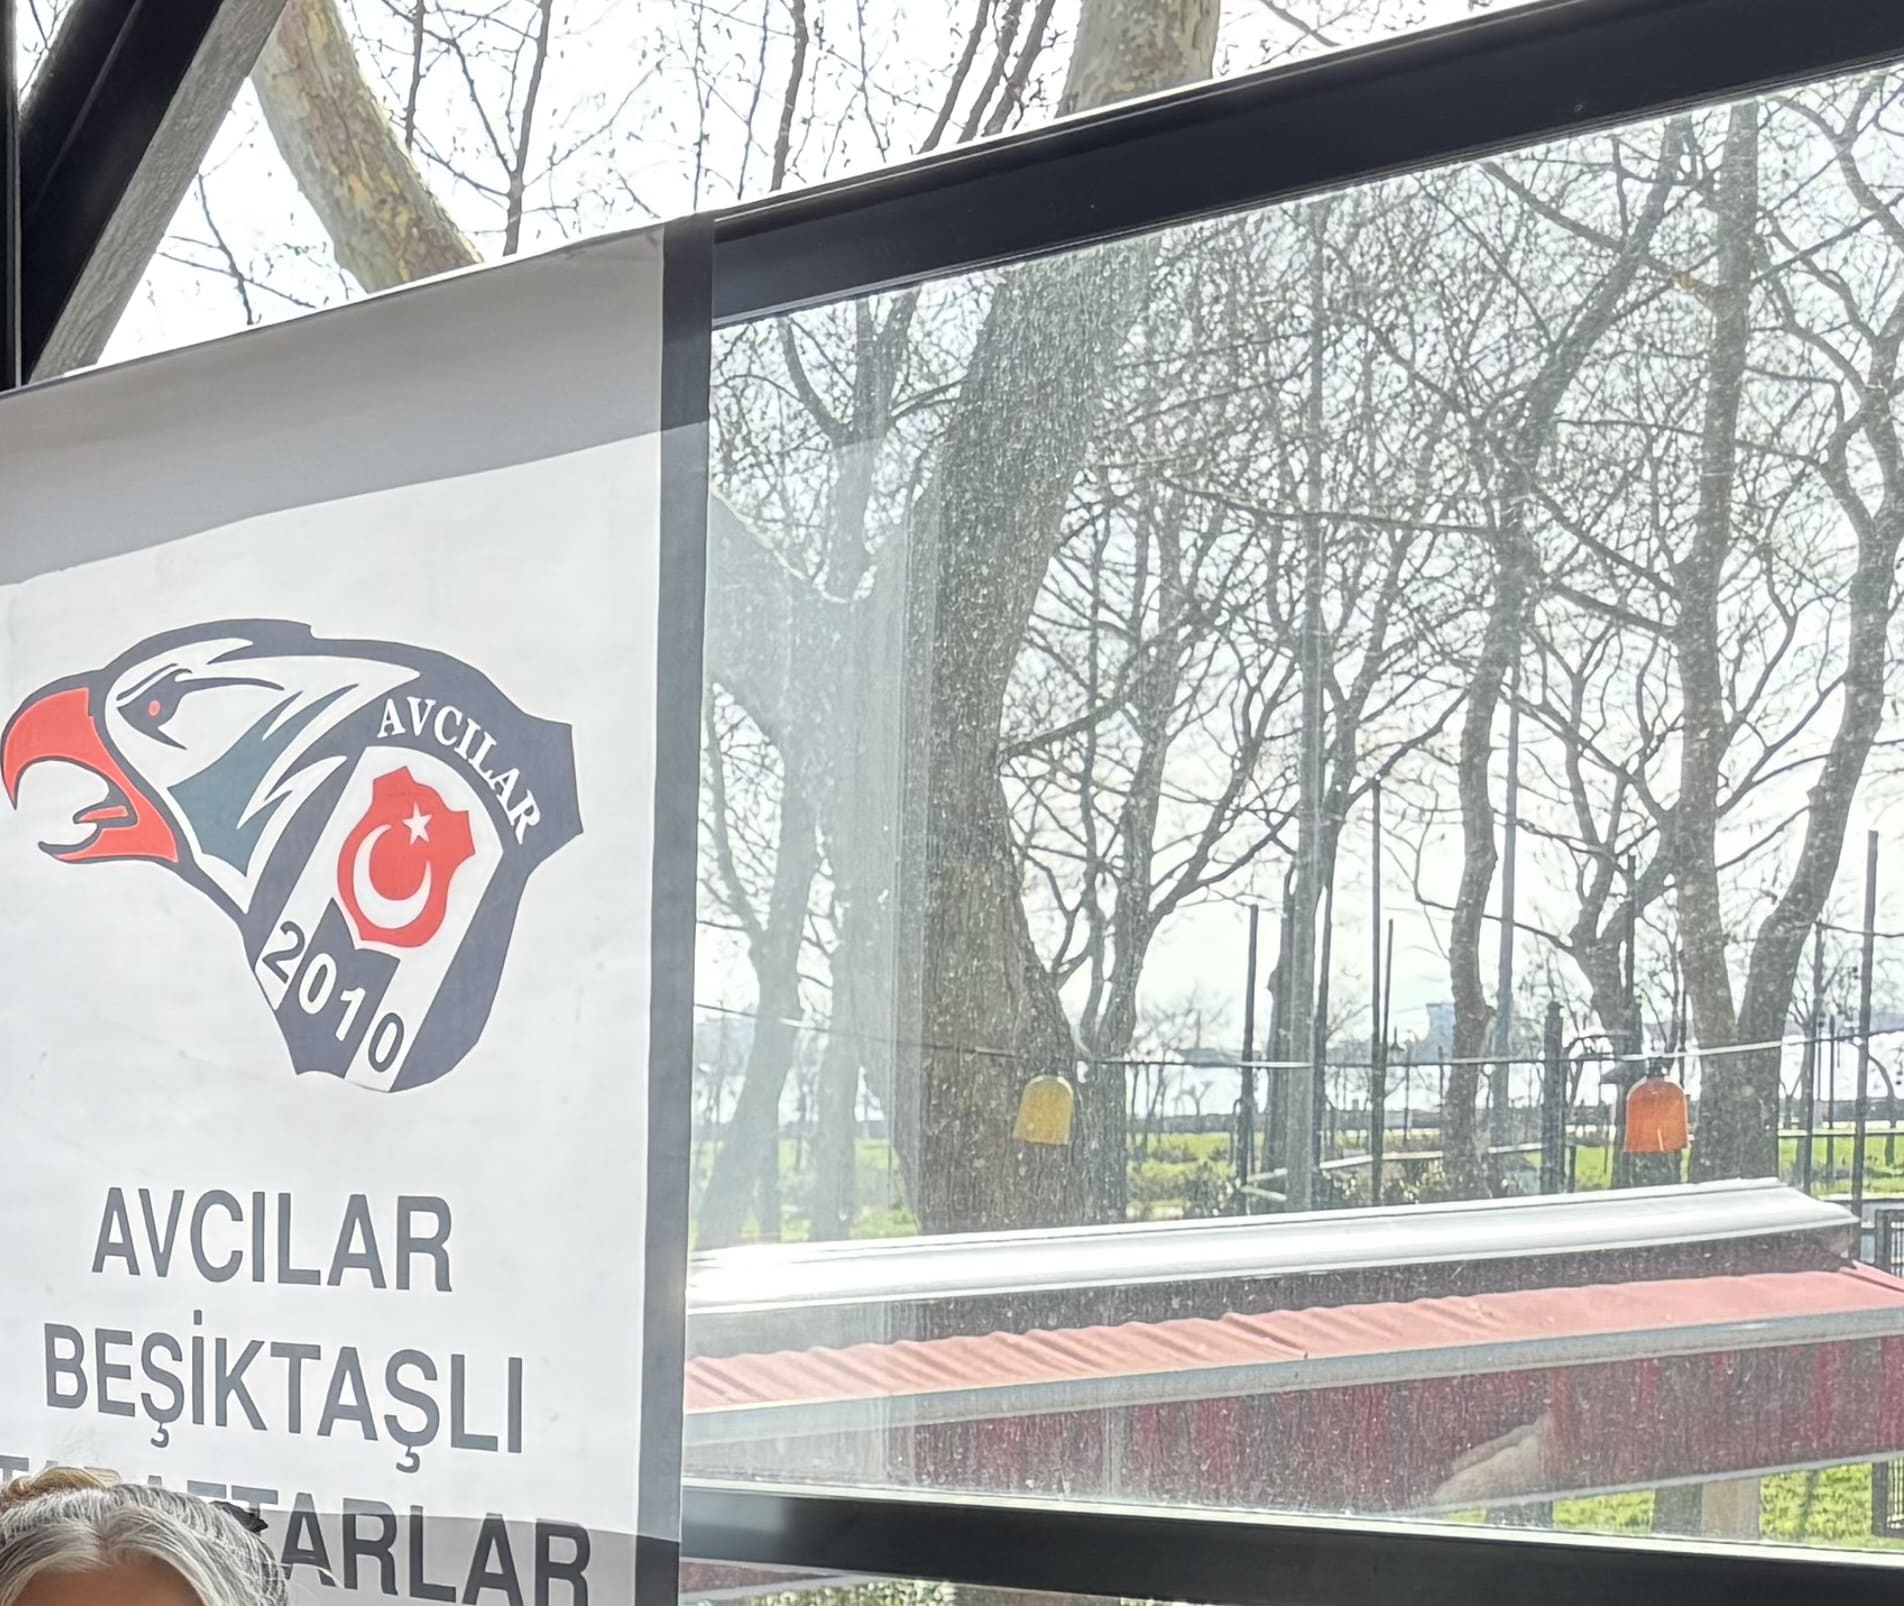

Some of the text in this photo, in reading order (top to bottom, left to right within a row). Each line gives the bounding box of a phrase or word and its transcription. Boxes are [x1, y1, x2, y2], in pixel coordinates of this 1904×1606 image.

[377, 696, 541, 845] AVCILAR
[262, 922, 405, 1073] 2010
[91, 1186, 454, 1293] AVCILAR
[43, 1309, 525, 1474] BEŞİKTAŞLI
